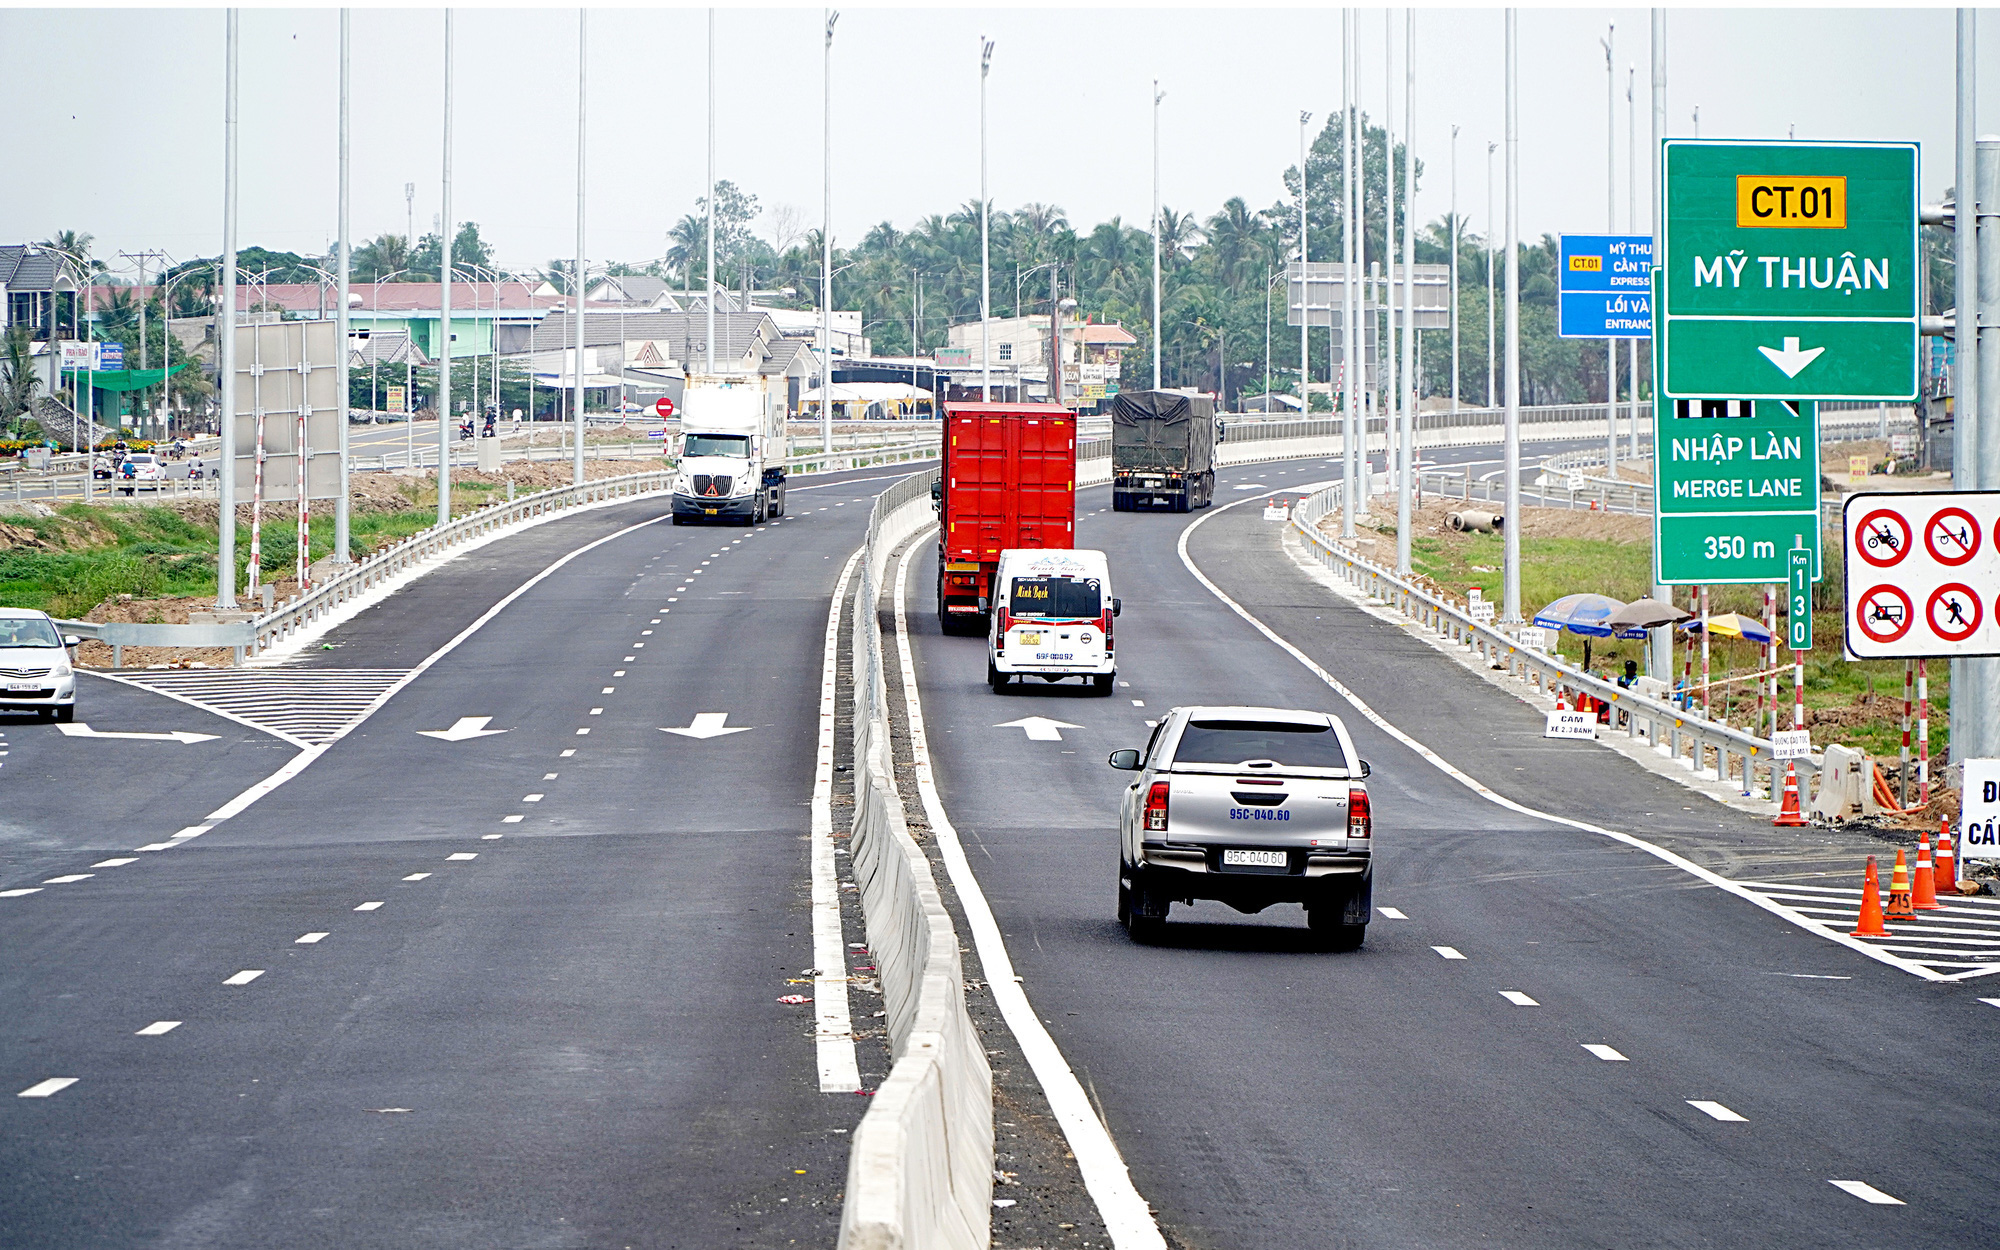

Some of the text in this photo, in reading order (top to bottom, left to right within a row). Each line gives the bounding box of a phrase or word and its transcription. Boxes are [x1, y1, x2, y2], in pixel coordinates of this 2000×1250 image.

[1751, 186, 1832, 218] CT.01
[1609, 242, 1627, 255] MỸ
[1573, 258, 1598, 269] CT.01
[1613, 257, 1638, 273] CẦN
[1694, 249, 1889, 295] MỸ THUẬN
[1610, 277, 1650, 286] EXPRESS
[1606, 295, 1650, 313] LỐI VÀ
[1672, 431, 1801, 465] NHẬP LÀN
[1673, 478, 1802, 498] MERGE LANE
[1704, 536, 1775, 559] 350 m
[1792, 555, 1807, 565] Km
[1983, 781, 2000, 803] Đ
[1230, 808, 1290, 821] 95C-040.60
[1968, 815, 2000, 845] CẤ
